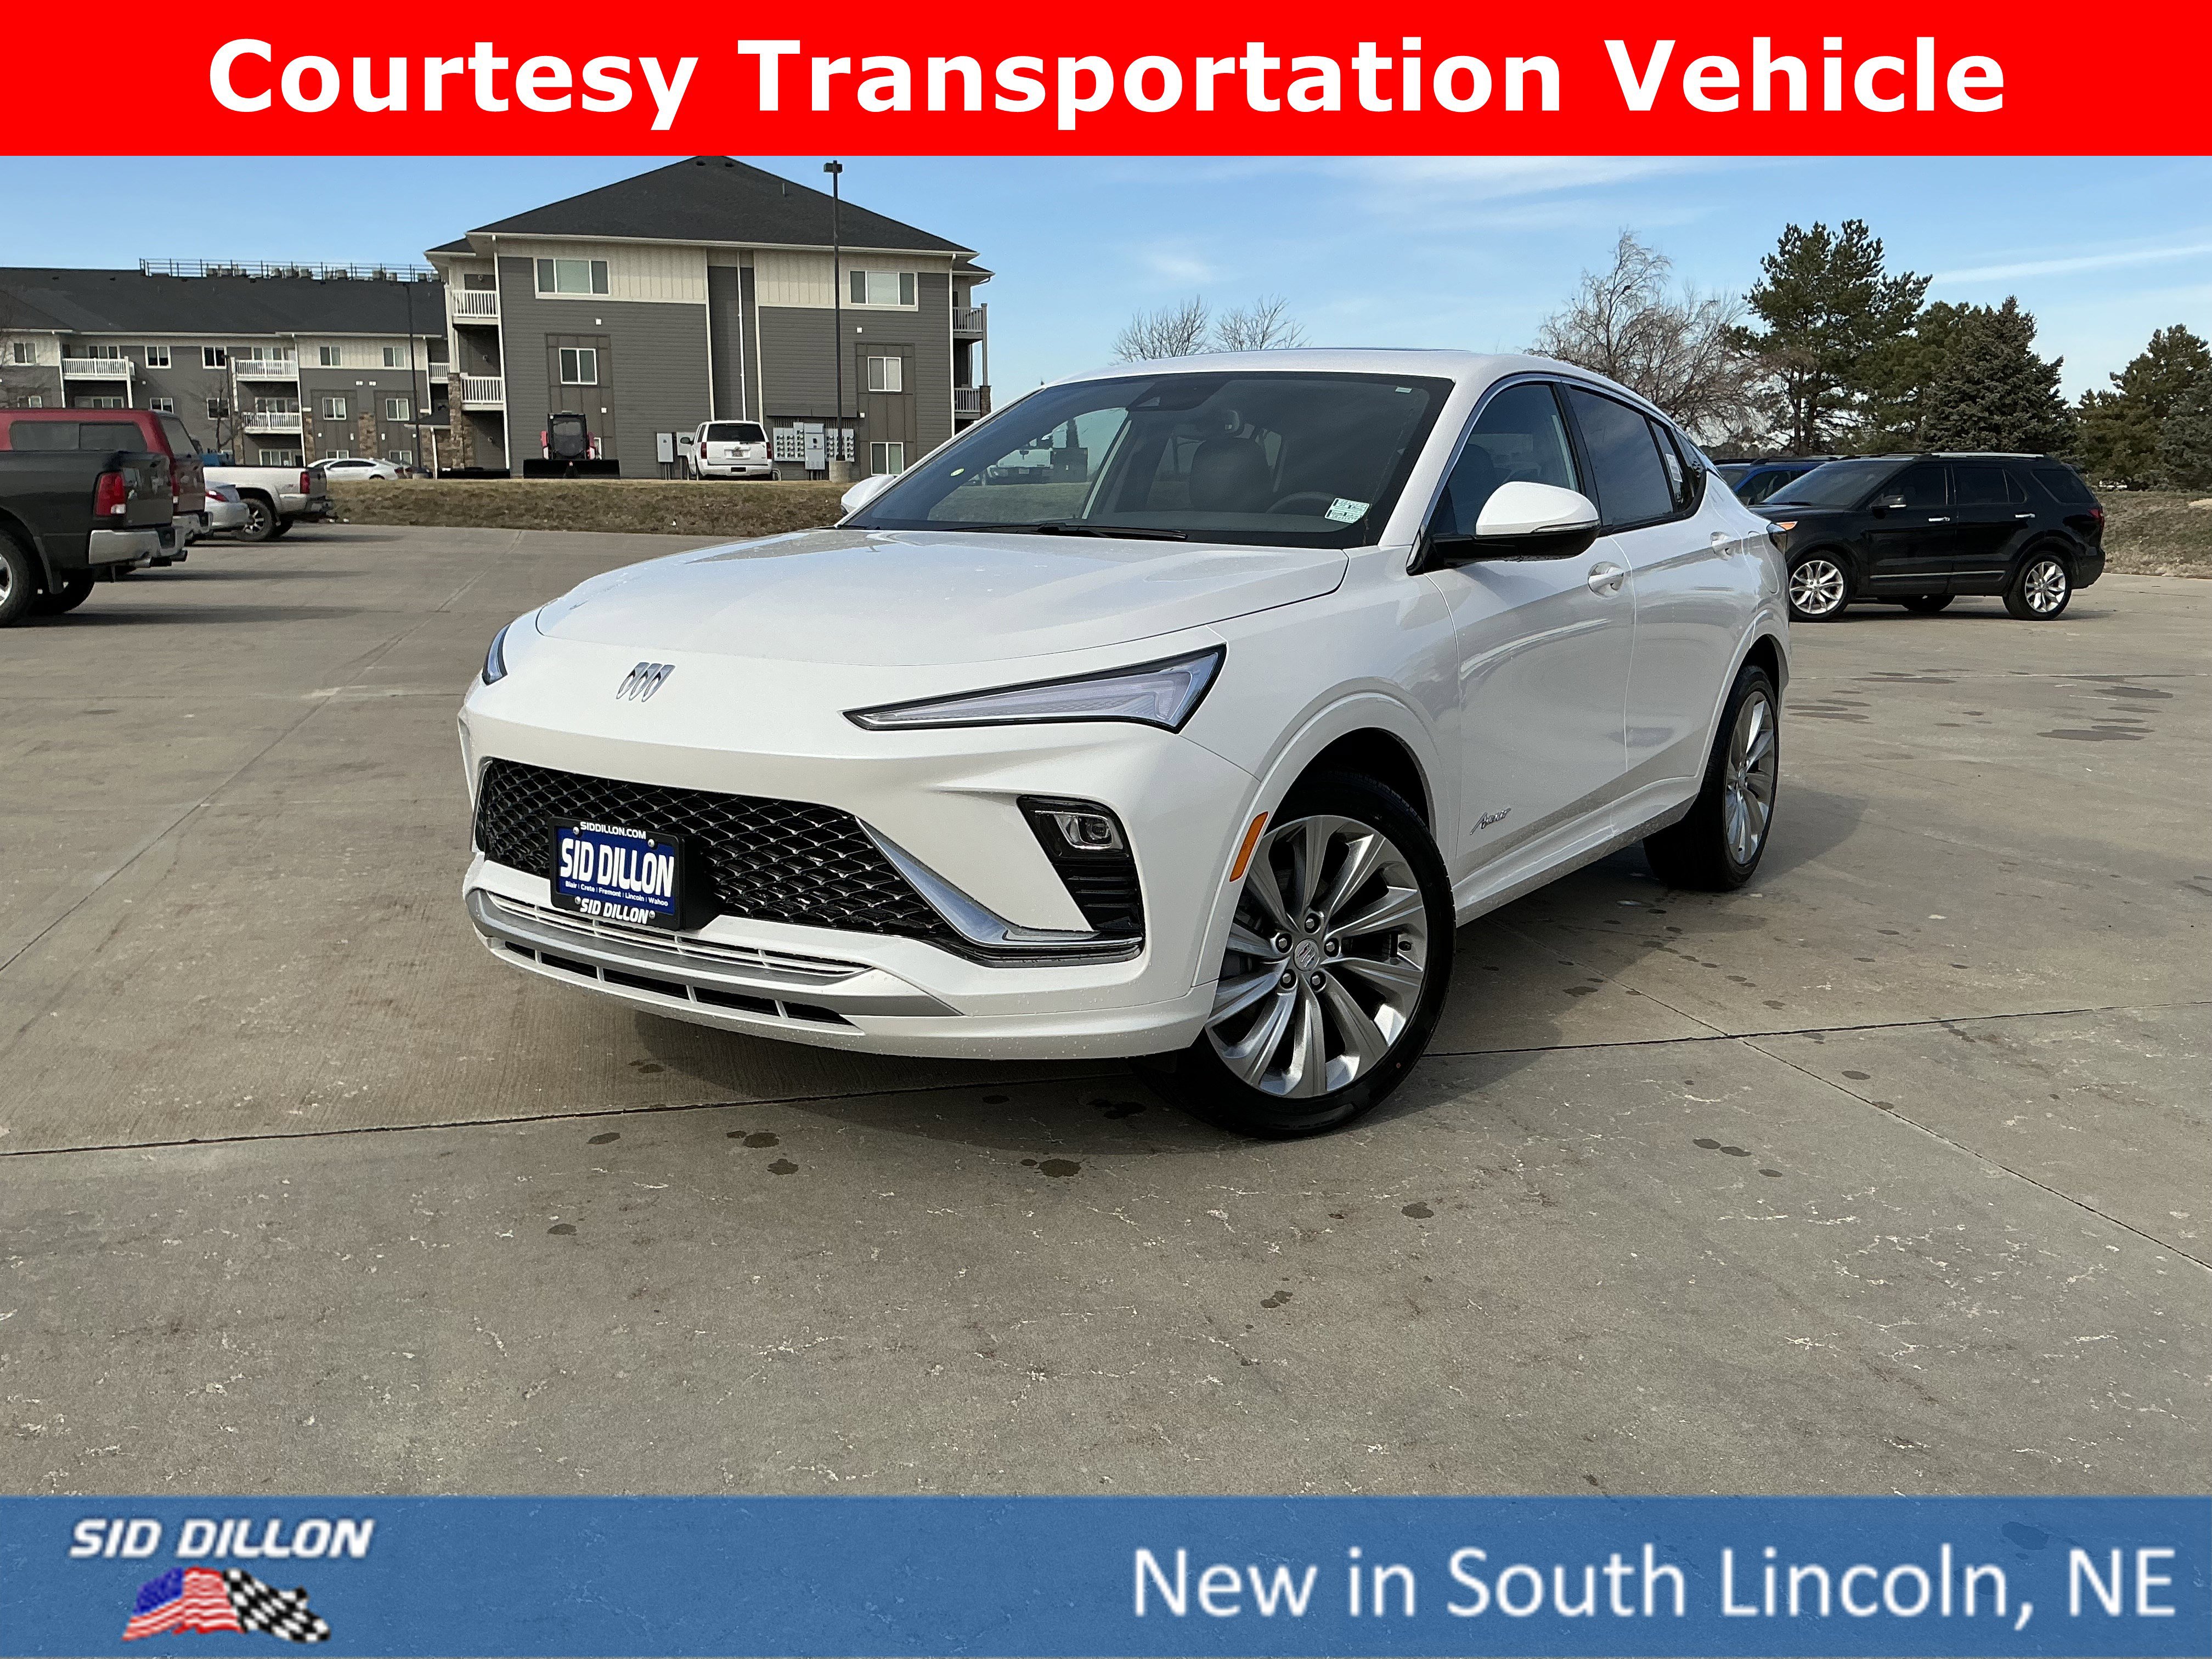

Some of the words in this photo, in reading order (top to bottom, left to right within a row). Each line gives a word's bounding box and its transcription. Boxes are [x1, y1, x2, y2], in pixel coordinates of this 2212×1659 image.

[580, 821, 646, 839] SIDDILLON.COM
[560, 838, 594, 882] SID
[597, 844, 674, 897] DILLON
[580, 884, 595, 893] Crete
[599, 887, 622, 898] Fremont
[625, 892, 645, 902] Lincoln
[648, 897, 668, 907] Wahoo
[580, 898, 601, 915] SID
[603, 902, 649, 924] DILLON
